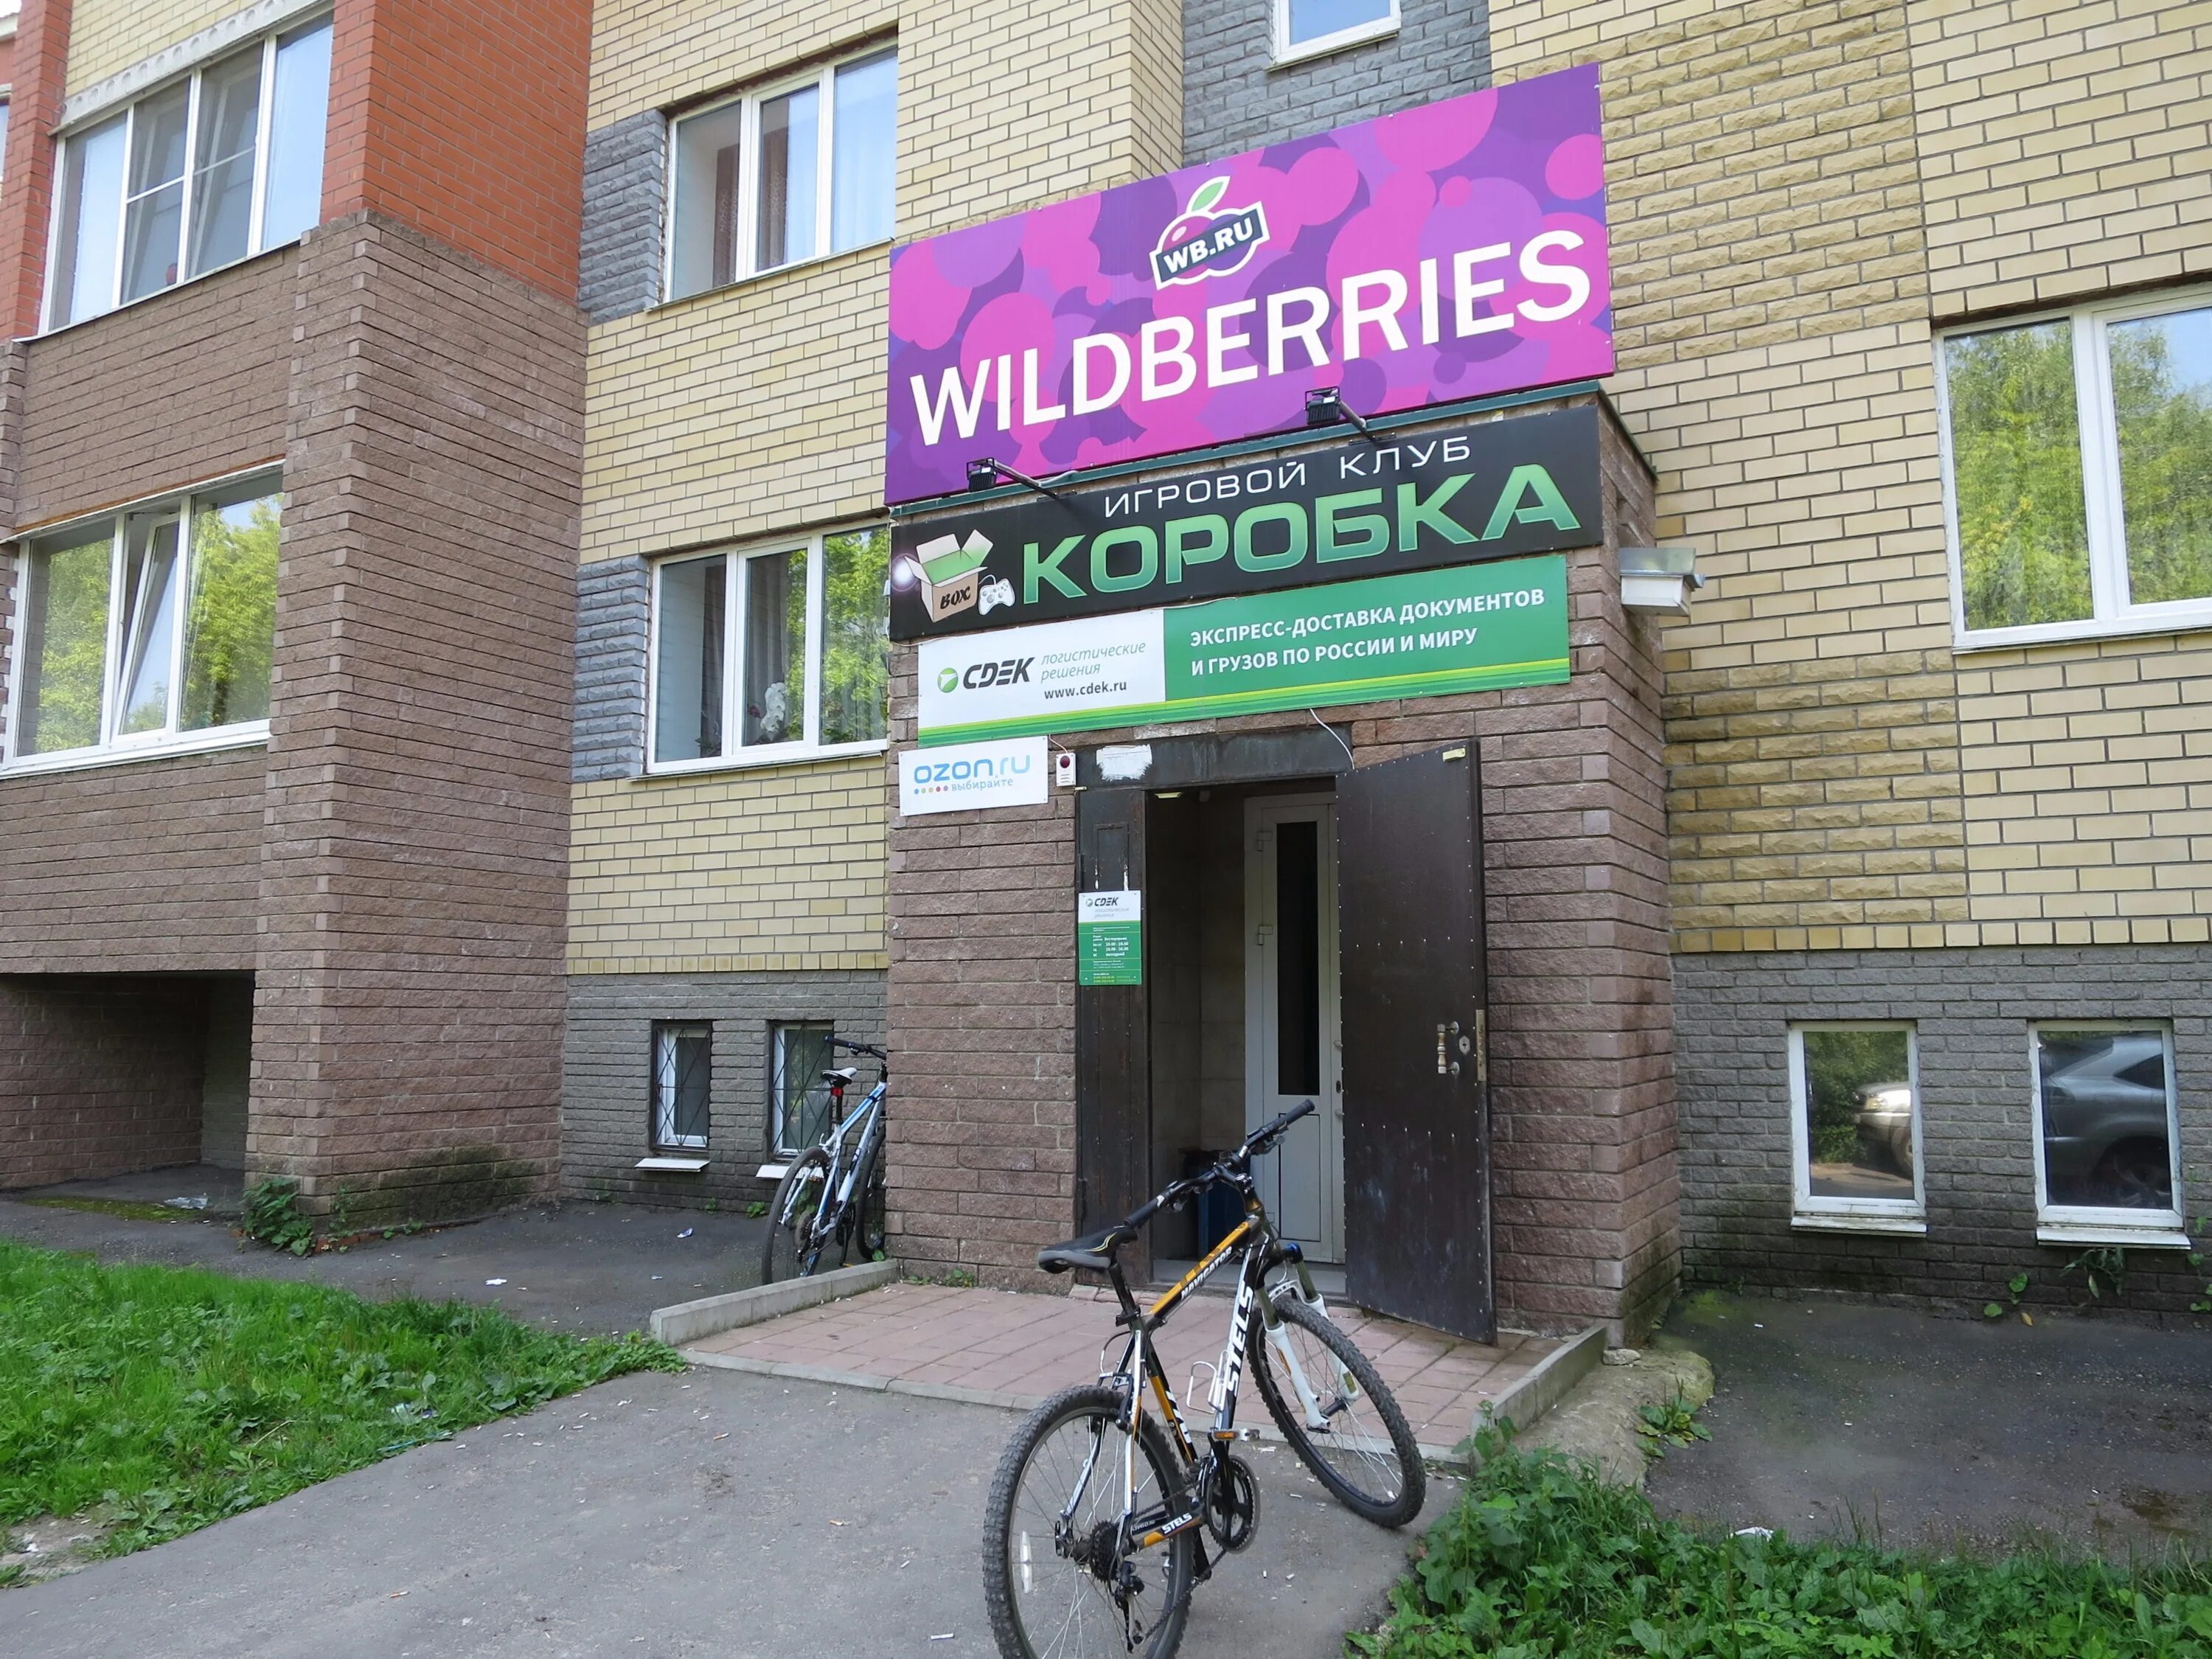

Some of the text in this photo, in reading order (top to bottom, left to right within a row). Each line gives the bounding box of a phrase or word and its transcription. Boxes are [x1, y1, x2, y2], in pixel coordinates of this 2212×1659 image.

[1163, 217, 1253, 274] WB.RU
[909, 229, 1591, 446] WILDBERRIES
[1105, 435, 1471, 518] ИГРОВОЙ КЛУБ
[1023, 464, 1582, 605] КОРОБКА
[939, 585, 971, 610] BOX
[1190, 588, 1545, 647] ЭКСПРЕСС-ДОСТАВКА ДОКУМЕНТОВ
[1040, 642, 1147, 665] логистические
[1191, 627, 1478, 676] И ГРУЗОВ ПО РОССИИ И МИРУ
[962, 657, 1035, 689] CDEK
[1040, 663, 1101, 684] решения
[1044, 680, 1127, 699] www.cdek.ru
[1094, 897, 1119, 907] CDEK
[1227, 1279, 1254, 1397] STELS
[1161, 1512, 1193, 1534] STELS
